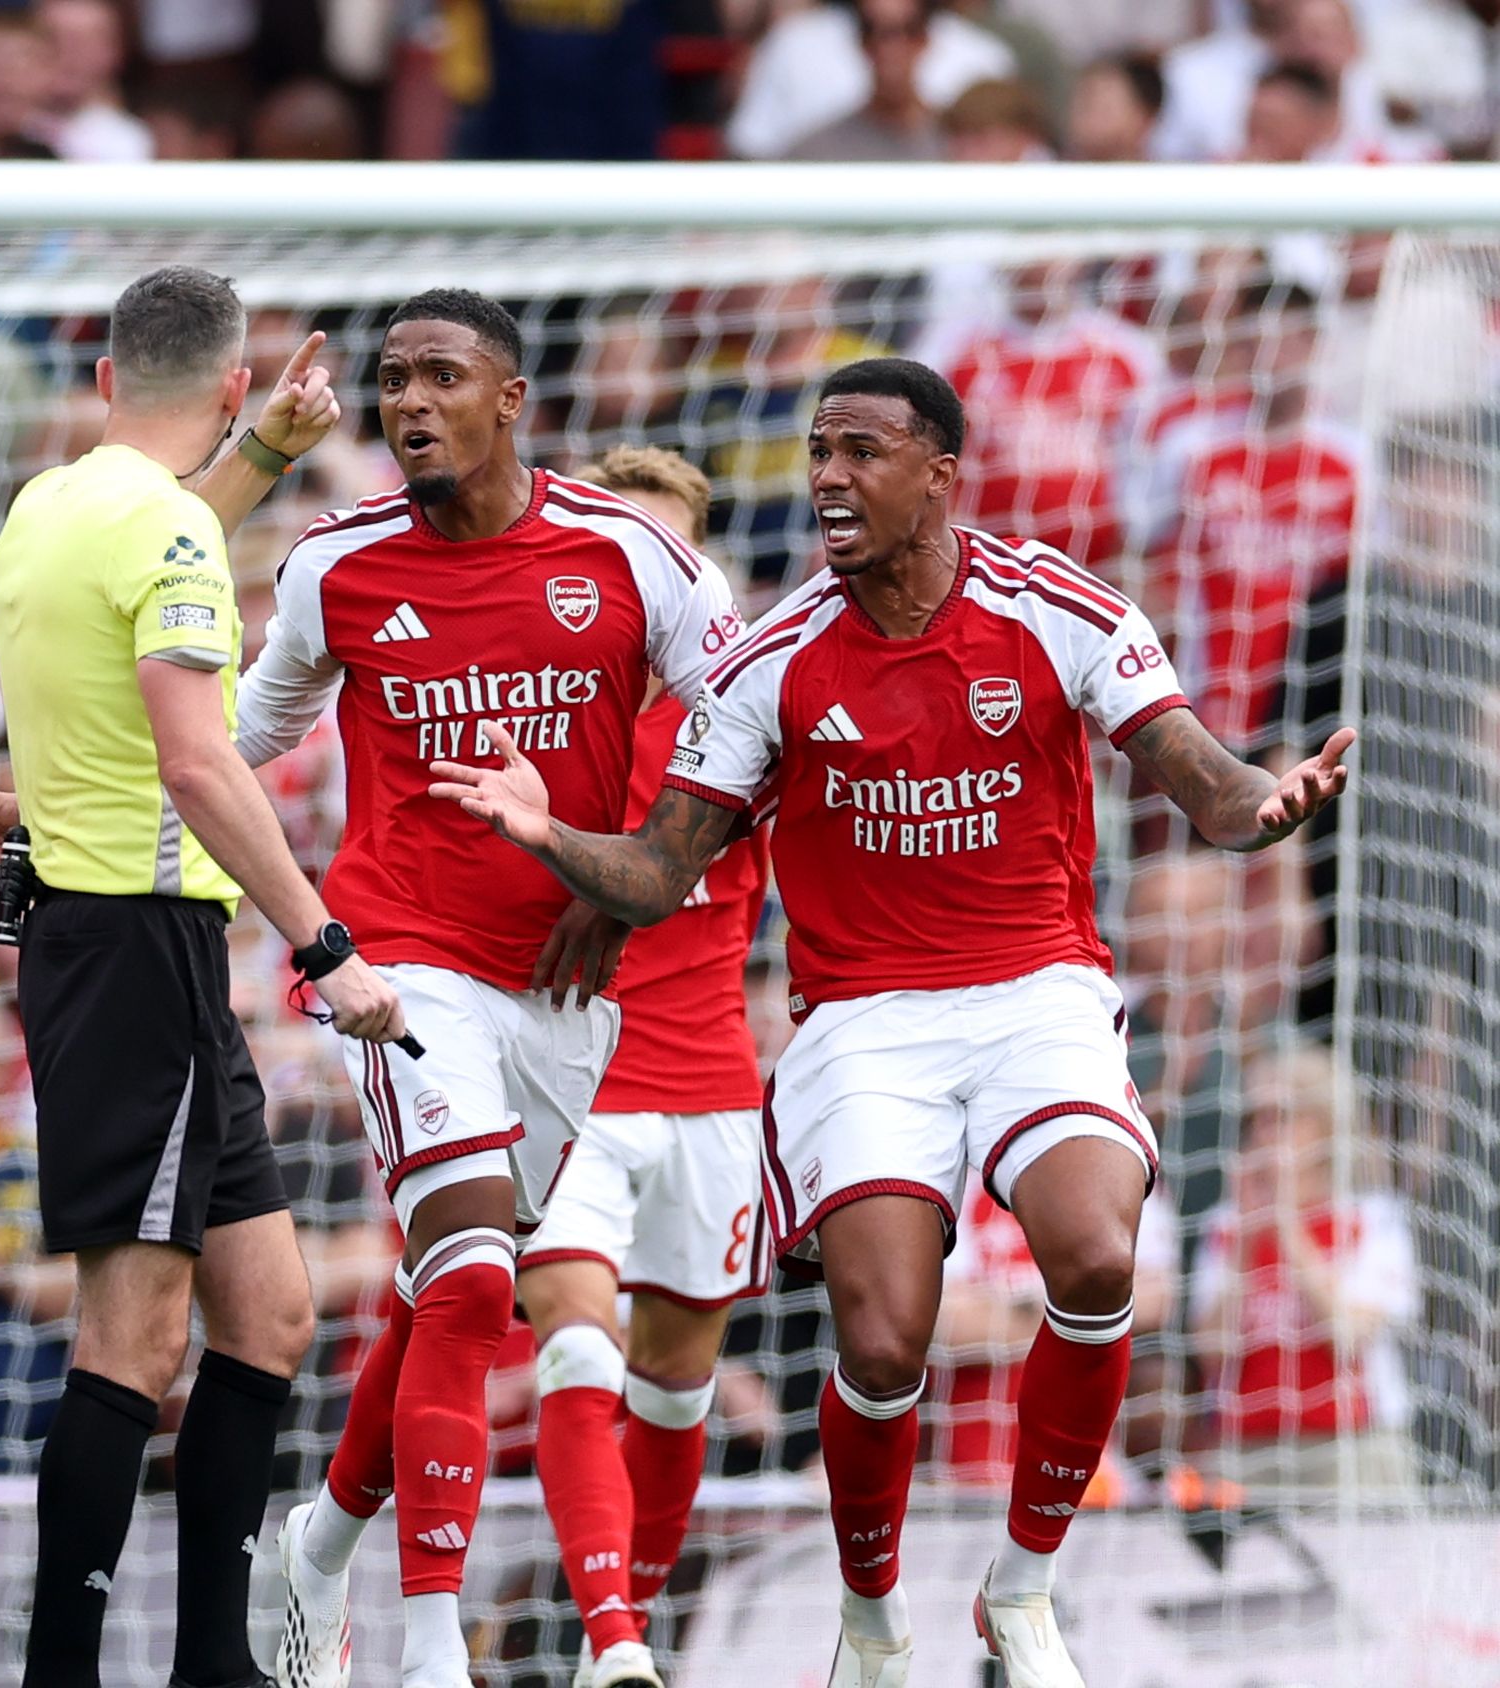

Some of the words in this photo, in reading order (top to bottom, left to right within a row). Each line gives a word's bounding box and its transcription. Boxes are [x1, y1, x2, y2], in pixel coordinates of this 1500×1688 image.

[153, 573, 226, 593] HuwsGray
[554, 585, 591, 595] Arsenal
[379, 663, 602, 720] Emirates
[976, 687, 1014, 698] Arsenal
[418, 720, 465, 760] FLY
[825, 762, 1023, 816] Emirates
[854, 815, 894, 854] FLY
[899, 810, 999, 857] BETTER
[723, 1202, 751, 1275] 8
[424, 1460, 474, 1484] AFC
[1040, 1460, 1087, 1481] AFC
[850, 1522, 892, 1542] AFC
[583, 1551, 622, 1573] AFC
